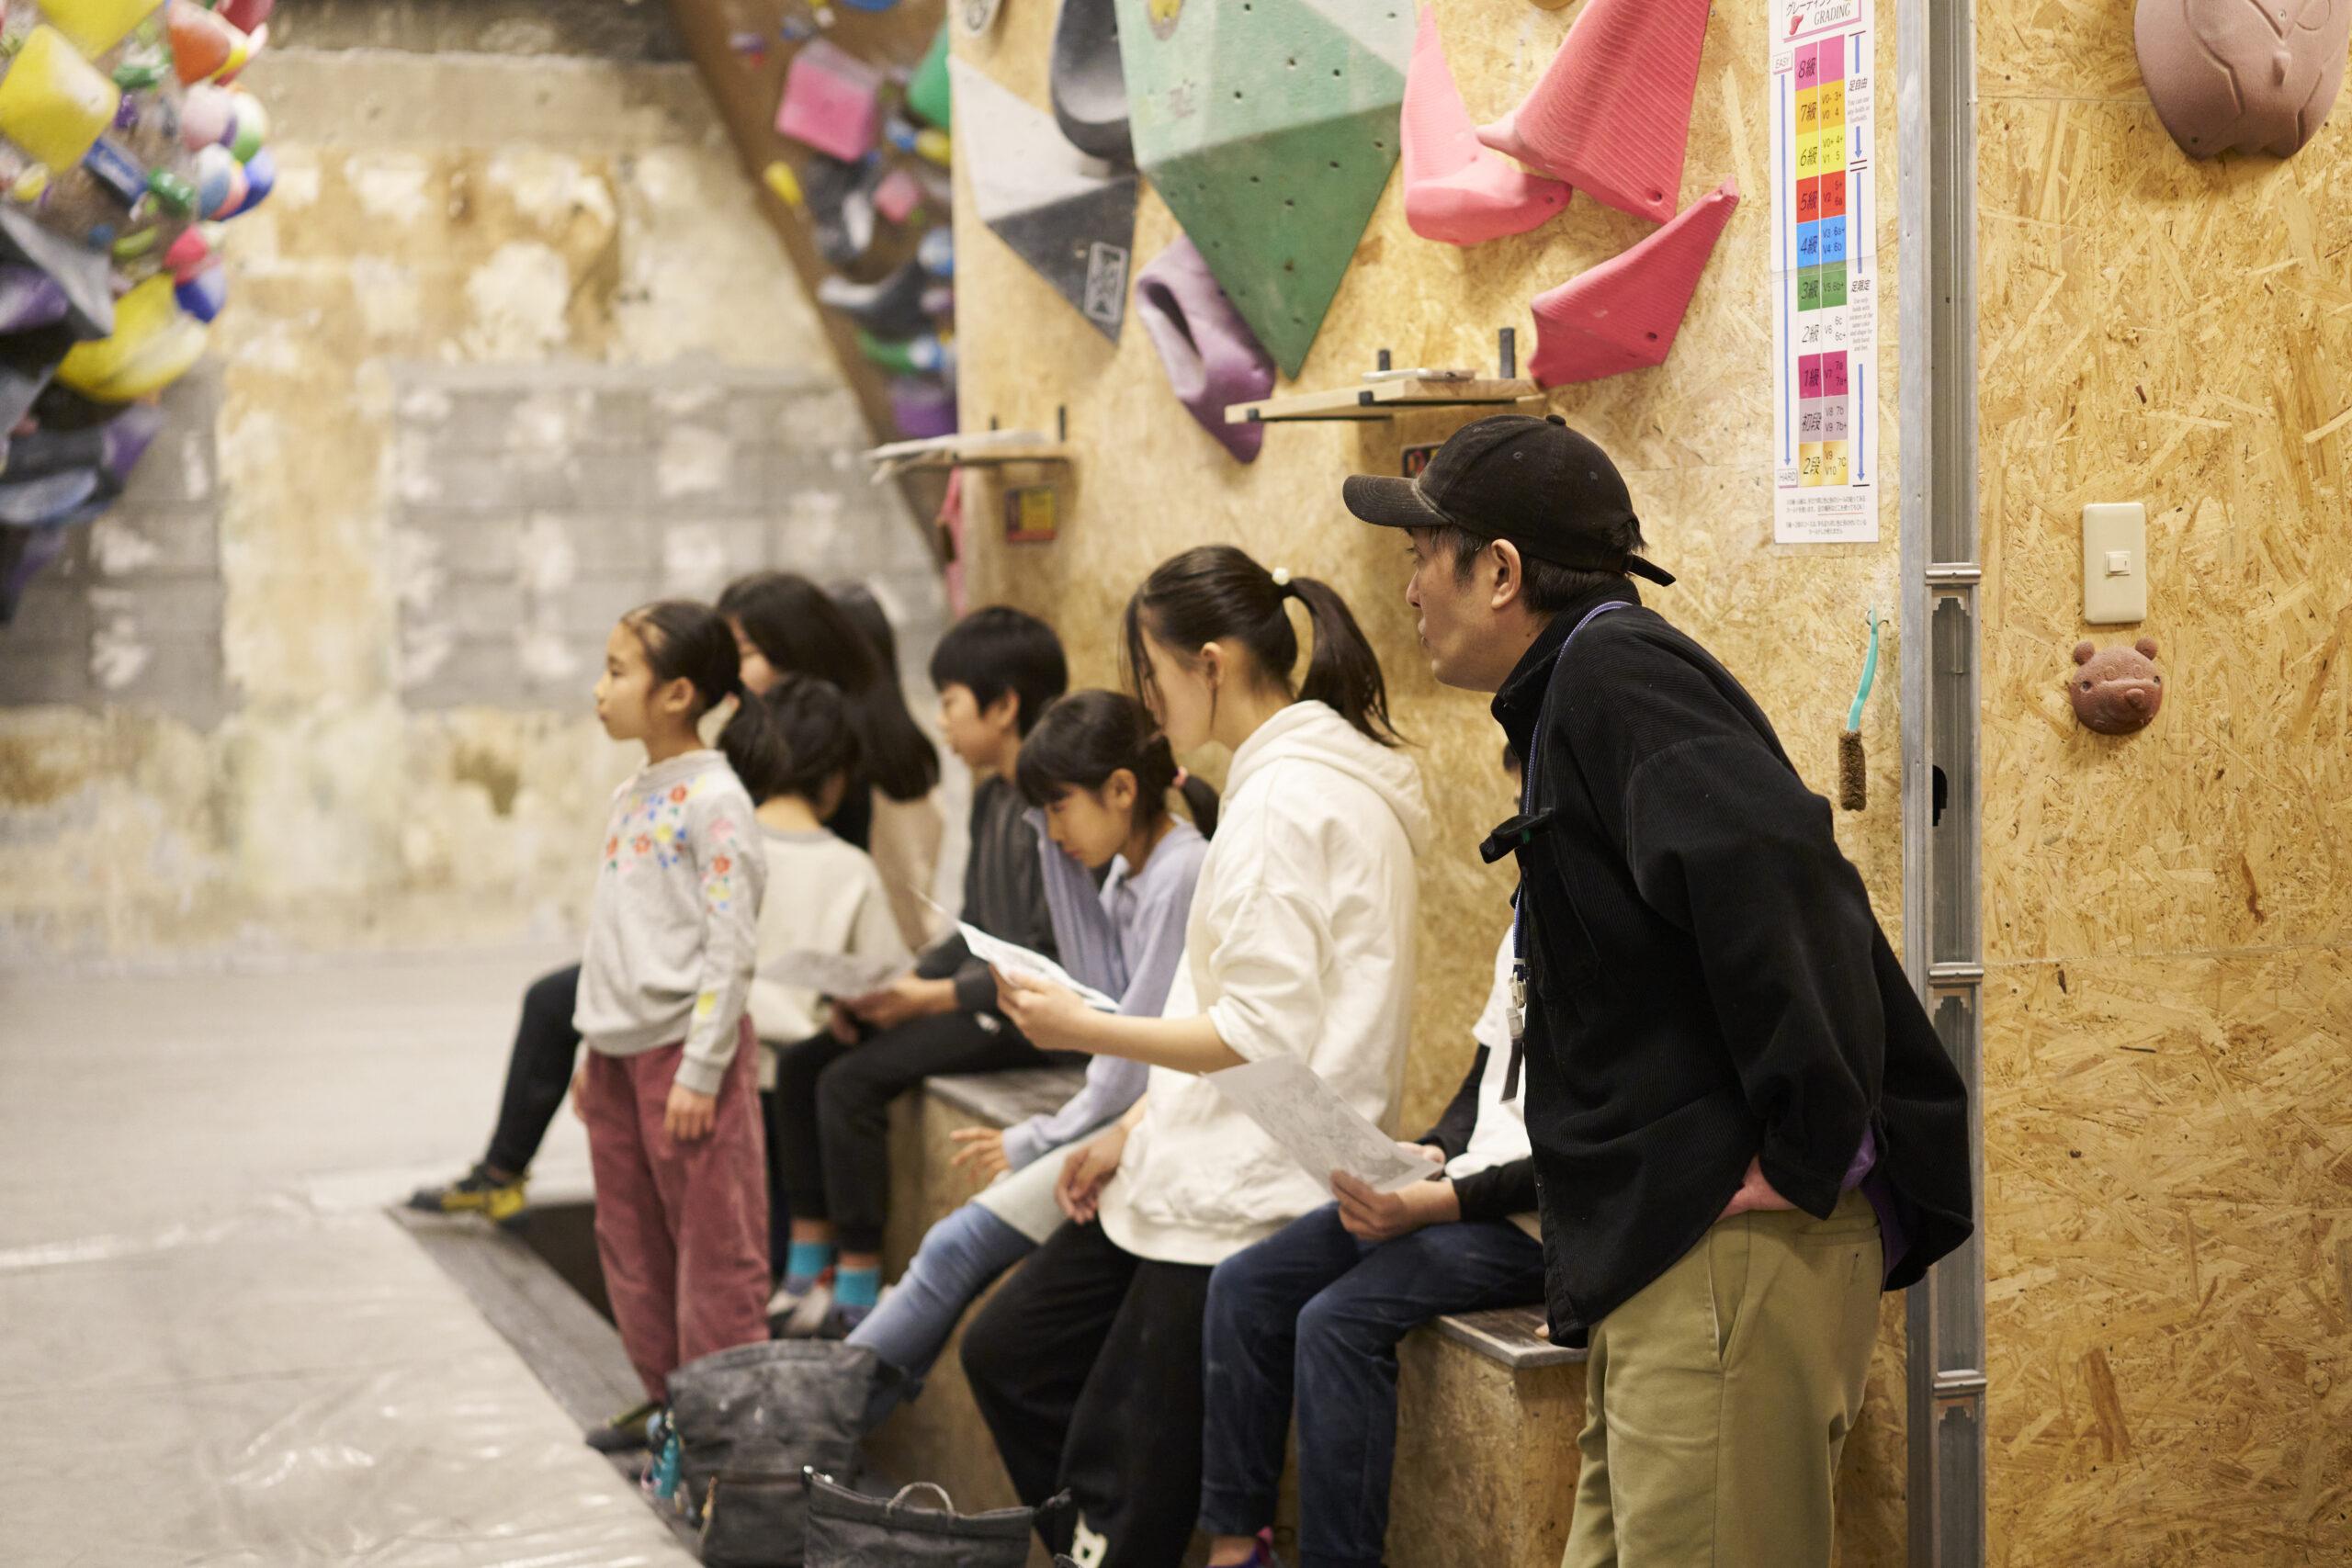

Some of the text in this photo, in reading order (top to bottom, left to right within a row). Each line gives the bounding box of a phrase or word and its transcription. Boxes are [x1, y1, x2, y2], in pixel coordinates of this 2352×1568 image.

[1814, 3, 1851, 26] GRADING
[1775, 57, 1791, 70] EASY
[1798, 57, 1816, 79] 8級
[1849, 77, 1868, 92] 足自由
[1801, 101, 1817, 122] 7級
[1800, 146, 1817, 166] 6級
[1823, 151, 1840, 164] V1 5
[1835, 180, 1842, 190] 5+
[1800, 190, 1817, 211] 5級
[1823, 191, 1831, 202] V2
[1823, 228, 1831, 239] V3
[1801, 235, 1817, 254] 4級
[1823, 243, 1831, 254] V4
[1801, 279, 1819, 300] 3級
[1802, 324, 1819, 344] 2級
[1825, 324, 1832, 334] V6
[1804, 368, 1819, 387] 1級
[1825, 369, 1833, 378] V7
[1826, 406, 1844, 417] V8 7b
[1802, 412, 1822, 432] 初段
[1826, 421, 1848, 432] V9 7b+
[1826, 450, 1834, 460] V9
[1803, 457, 1821, 475] 2段
[1826, 466, 1837, 476] V10
[1780, 470, 1796, 482] HARD
